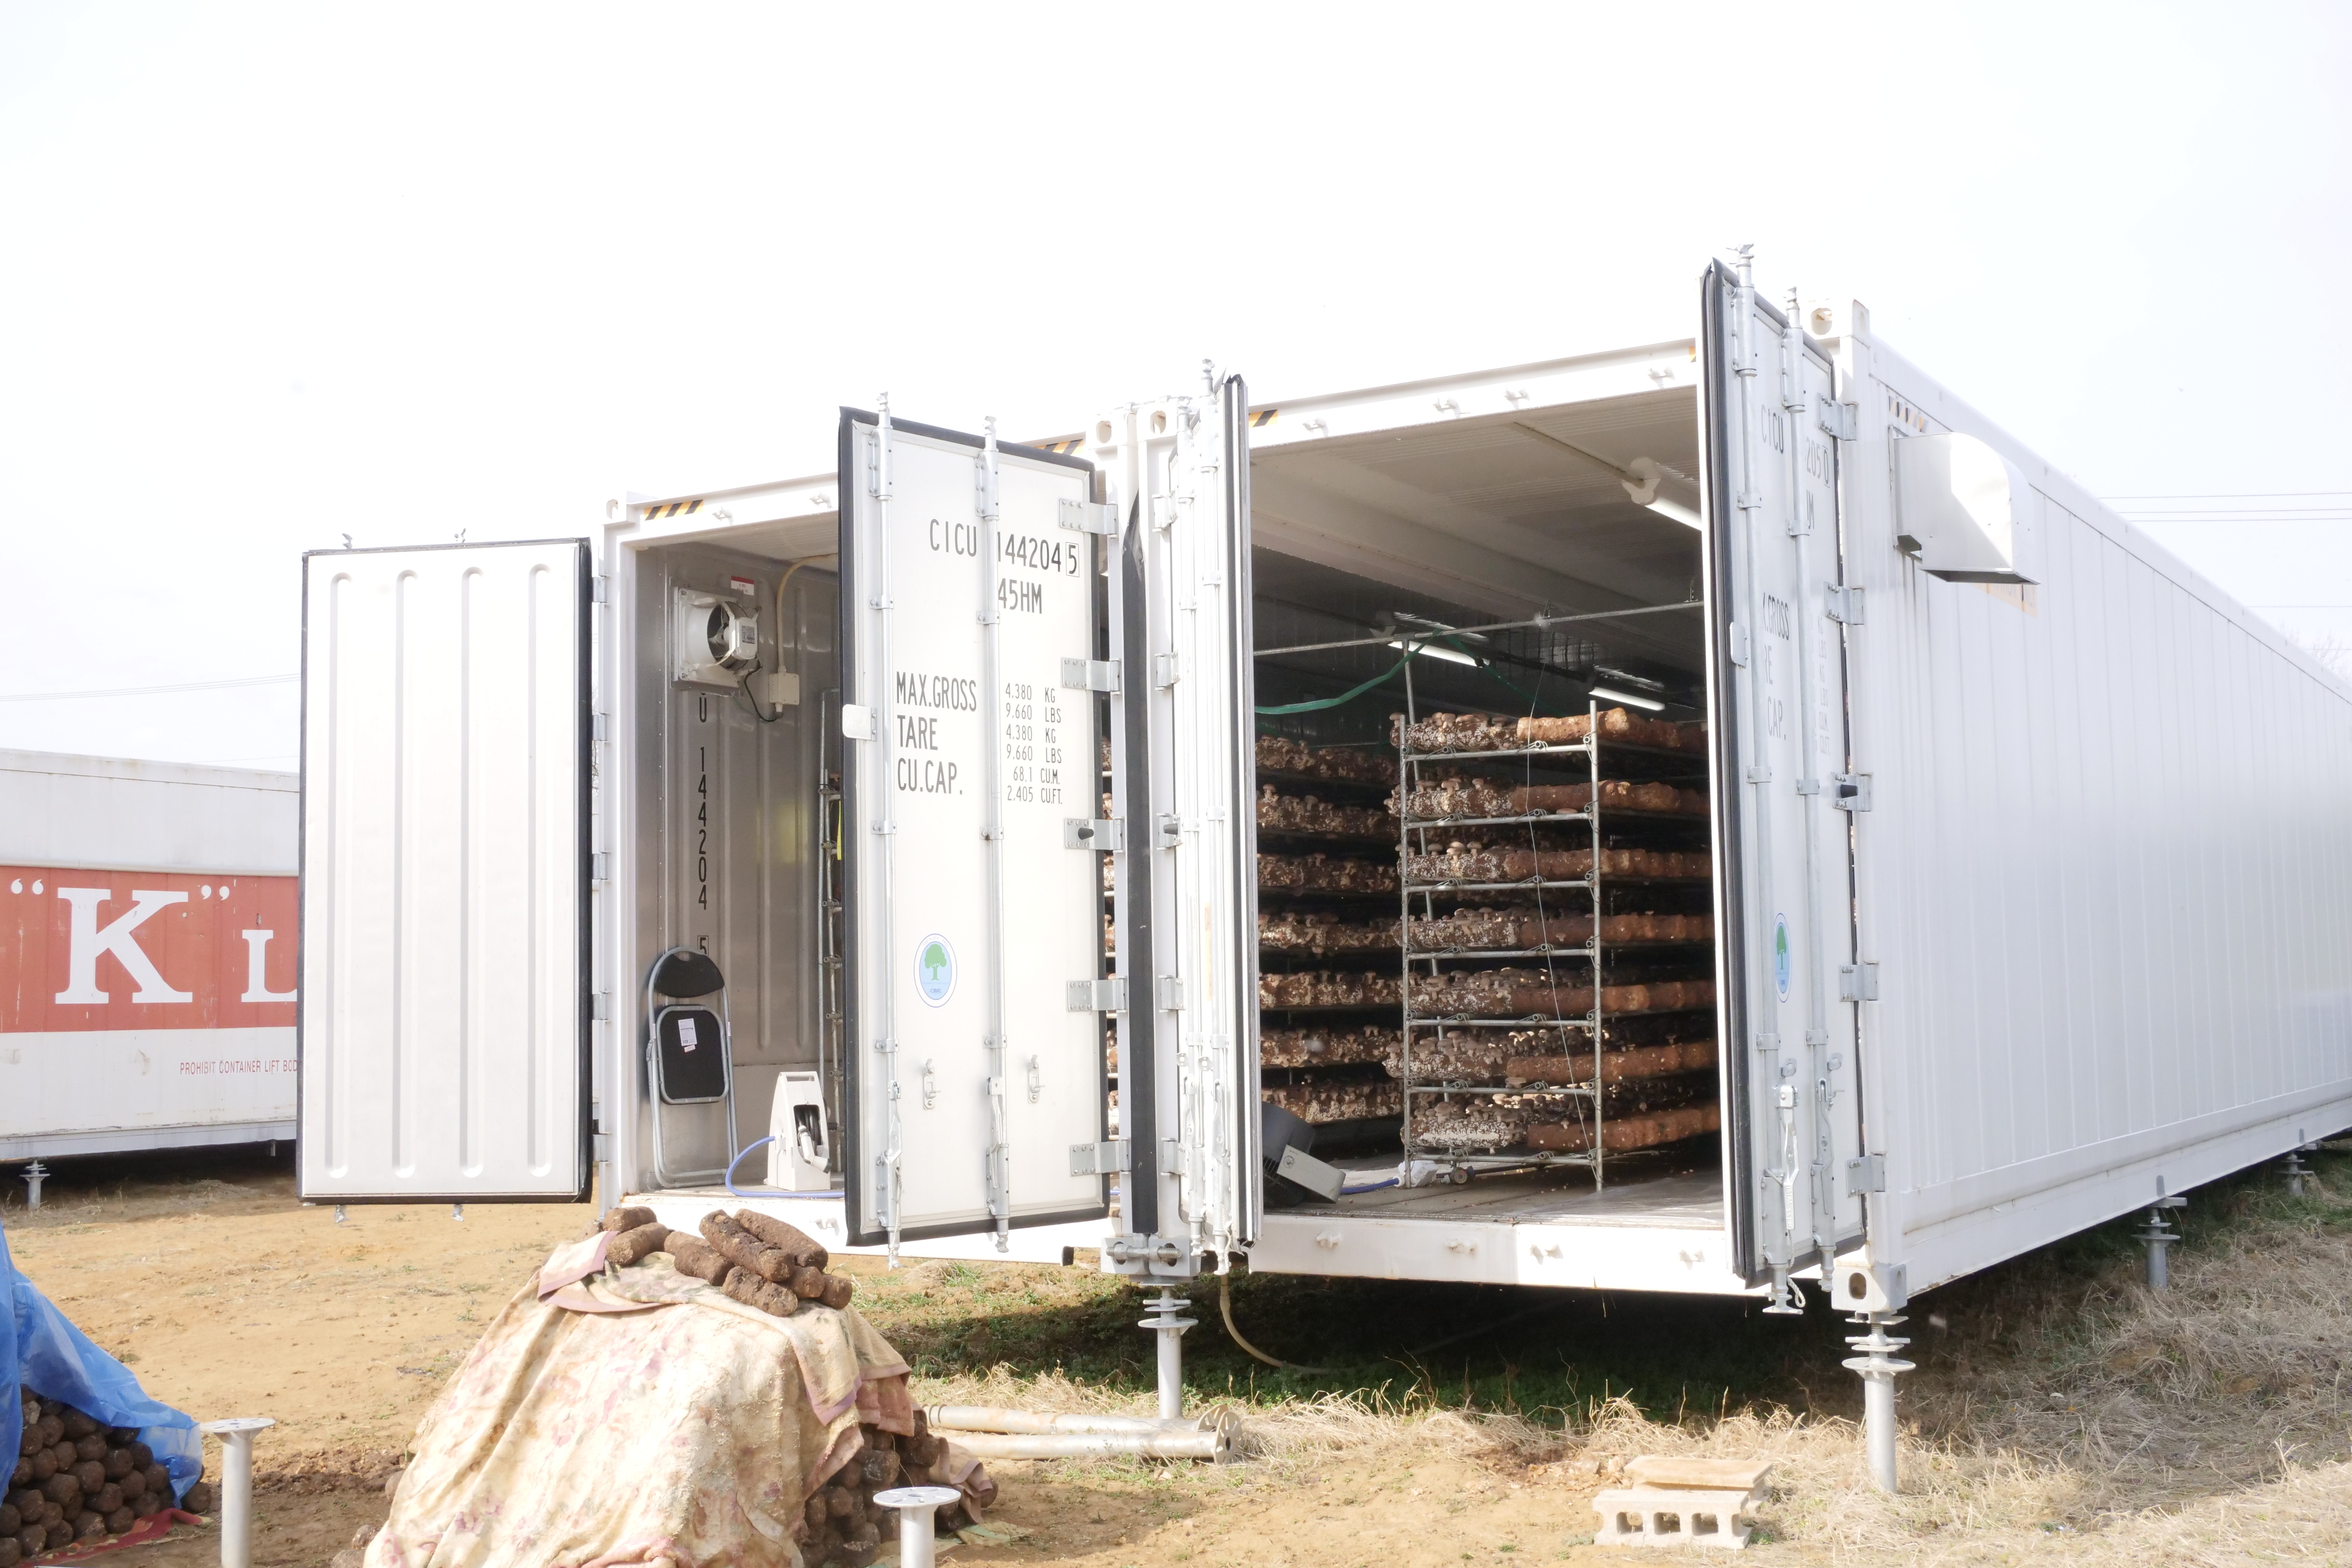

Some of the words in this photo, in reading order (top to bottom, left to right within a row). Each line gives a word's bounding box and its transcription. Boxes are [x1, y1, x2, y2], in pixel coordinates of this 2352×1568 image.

[1761, 404, 1784, 454] CICU
[930, 518, 976, 557] CICU
[997, 531, 1062, 573] 144204
[998, 577, 1043, 614] 45HM
[896, 671, 977, 712] MAX.GROSS
[1005, 682, 1032, 701] 4,380
[1045, 687, 1055, 703] KG
[699, 692, 707, 723] U
[1006, 702, 1032, 720] 9,660
[1045, 706, 1061, 723] LBS
[897, 714, 939, 750] TARE
[1006, 724, 1033, 741] 4,380
[1045, 727, 1056, 744] KG
[1007, 744, 1033, 761] 9,660
[1046, 747, 1062, 764] LBS
[1013, 765, 1032, 782] 68.1
[1040, 768, 1060, 785] CU.M.
[1007, 785, 1033, 802] 2,405
[1041, 787, 1063, 804] CU.FT.
[180, 1062, 216, 1075] PROHIBIT
[219, 1060, 261, 1074] CONTAINER
[265, 1059, 280, 1073] LIFT
